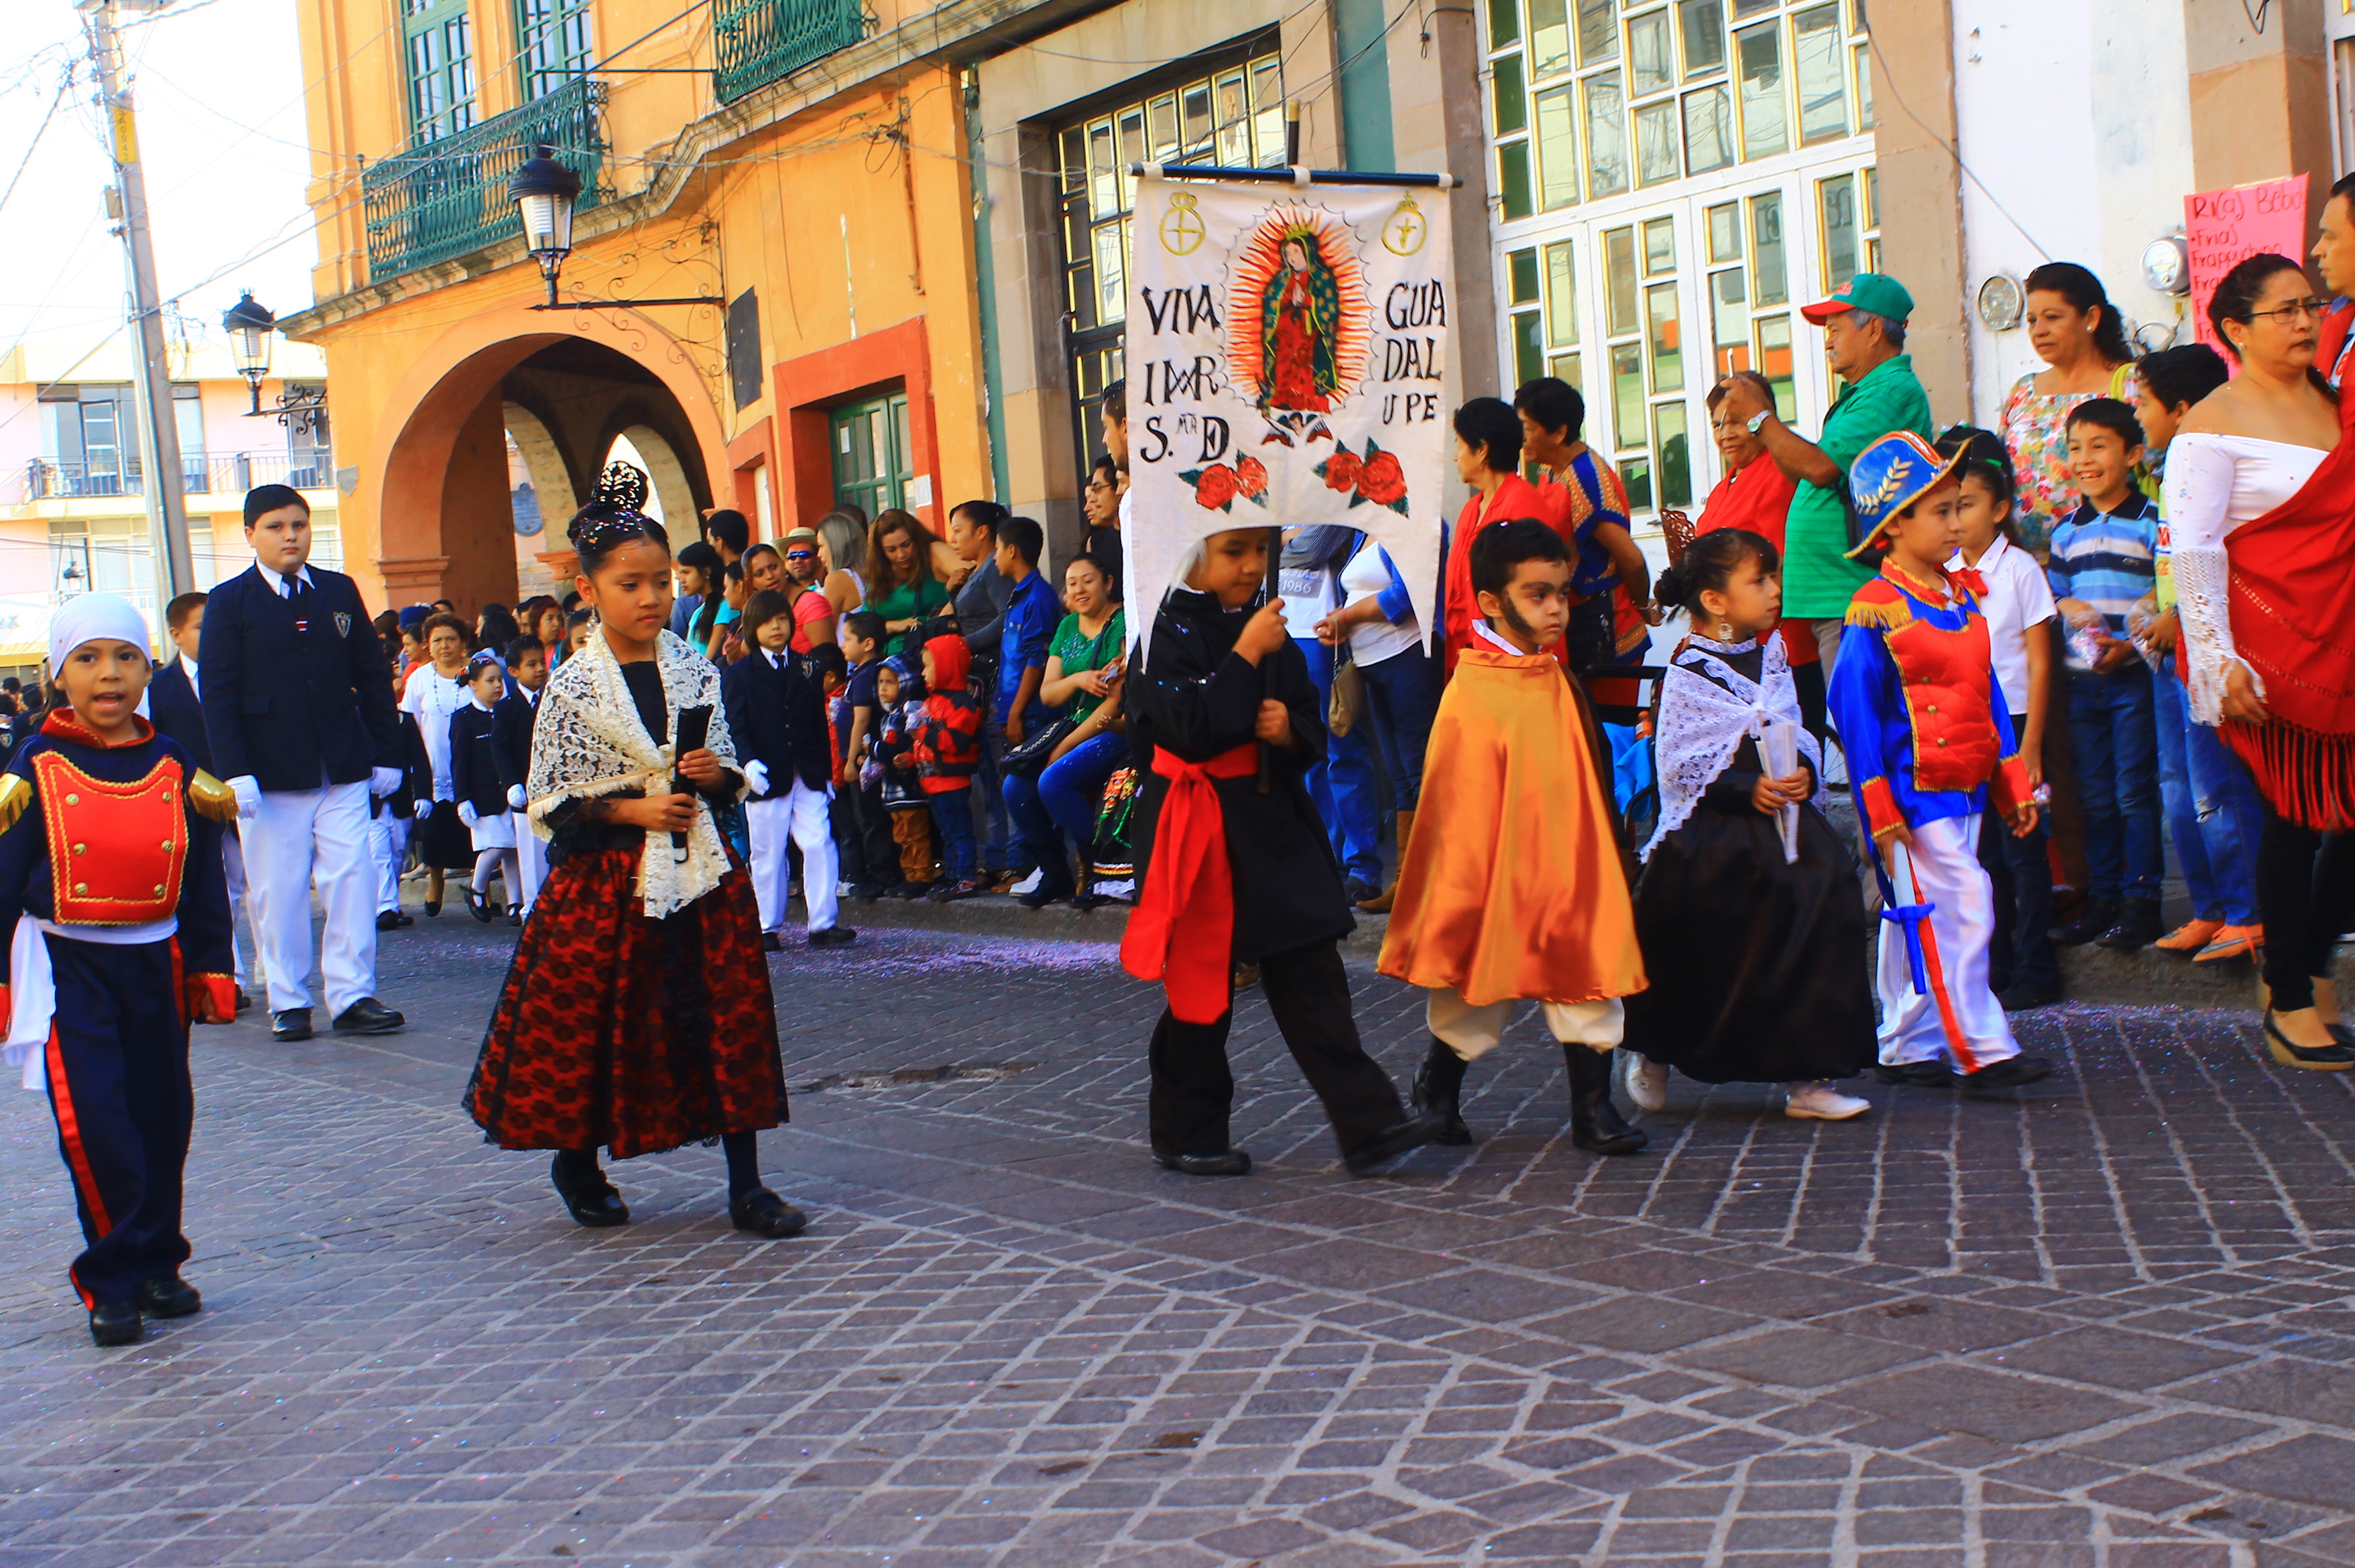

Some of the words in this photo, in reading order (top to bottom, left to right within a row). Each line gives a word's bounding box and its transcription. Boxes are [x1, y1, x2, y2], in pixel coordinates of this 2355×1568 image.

[1142, 284, 1222, 336] VIVA
[1386, 278, 1447, 331] GUA
[1383, 337, 1442, 383] DAL
[1282, 580, 1312, 594] 1986
